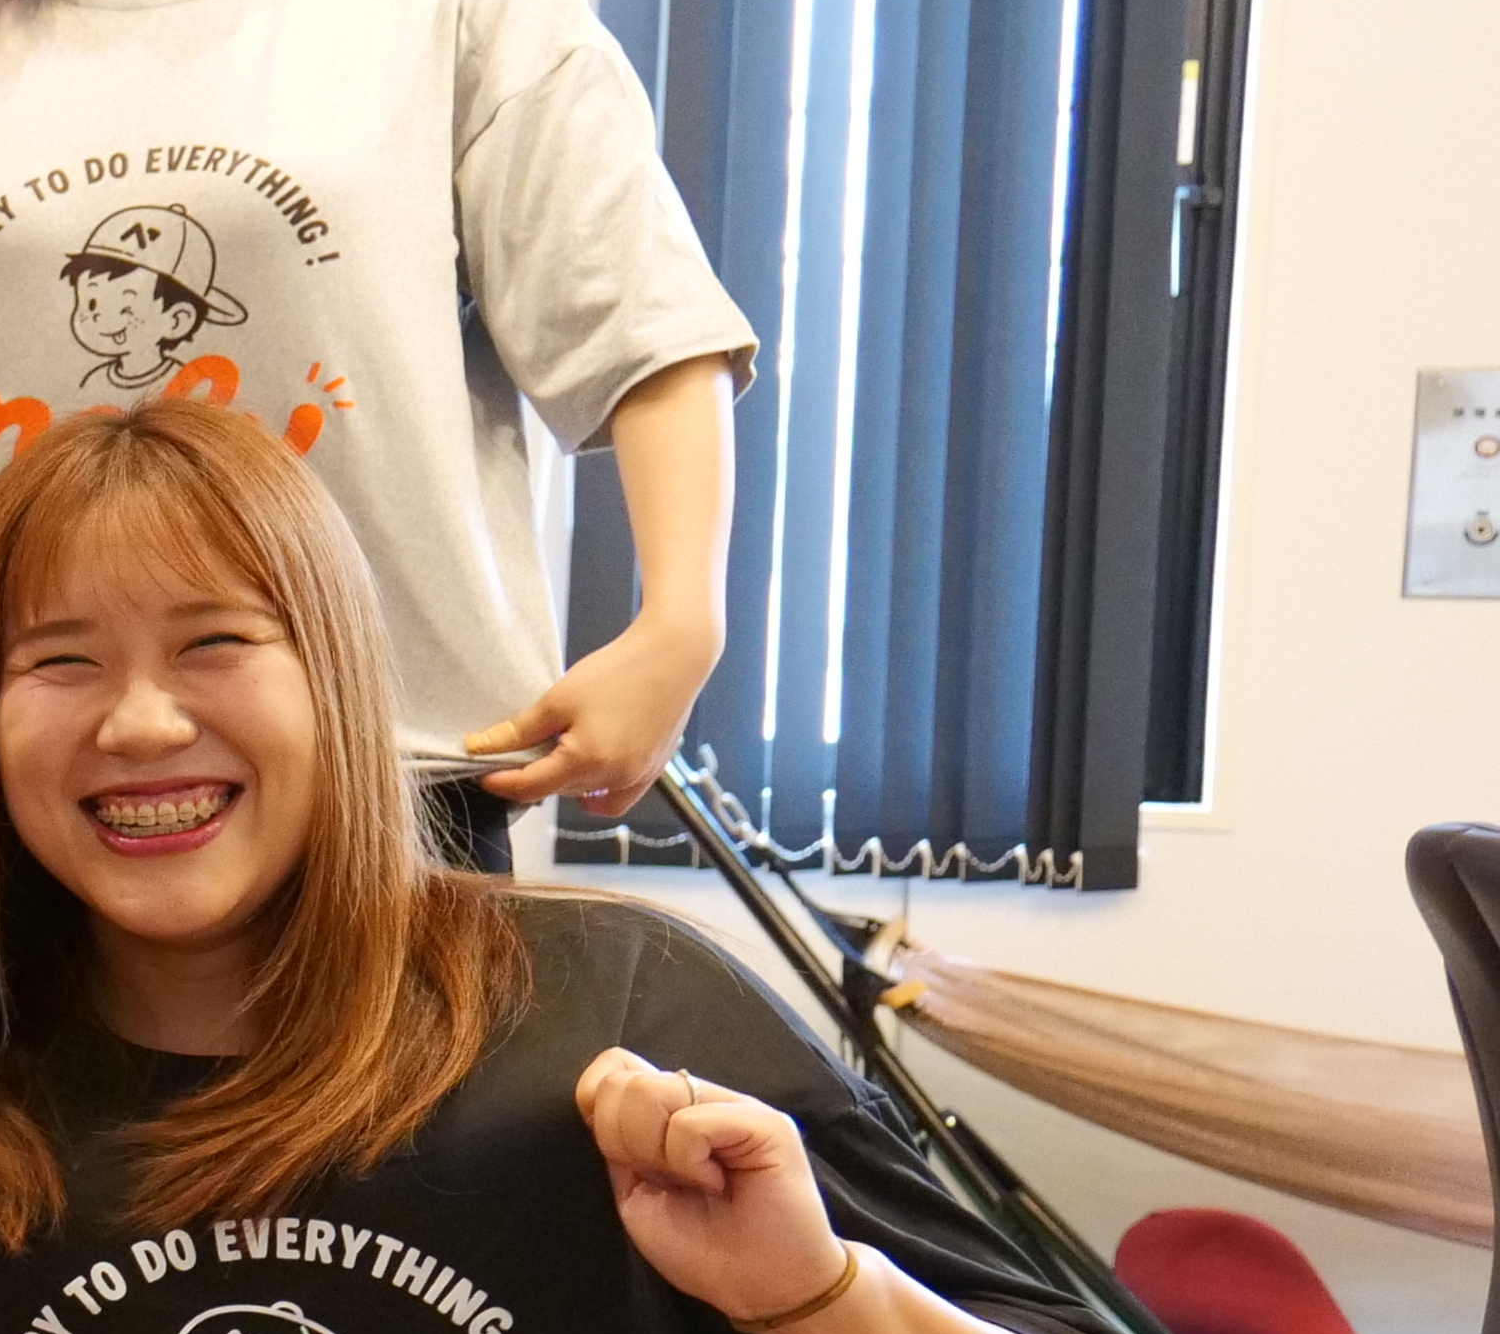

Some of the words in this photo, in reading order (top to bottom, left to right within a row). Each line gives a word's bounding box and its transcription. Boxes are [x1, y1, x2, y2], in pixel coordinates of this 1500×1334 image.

[24, 168, 70, 203] TO
[83, 151, 129, 186] DO
[63, 1260, 128, 1316] TO
[130, 1228, 198, 1284] DO
